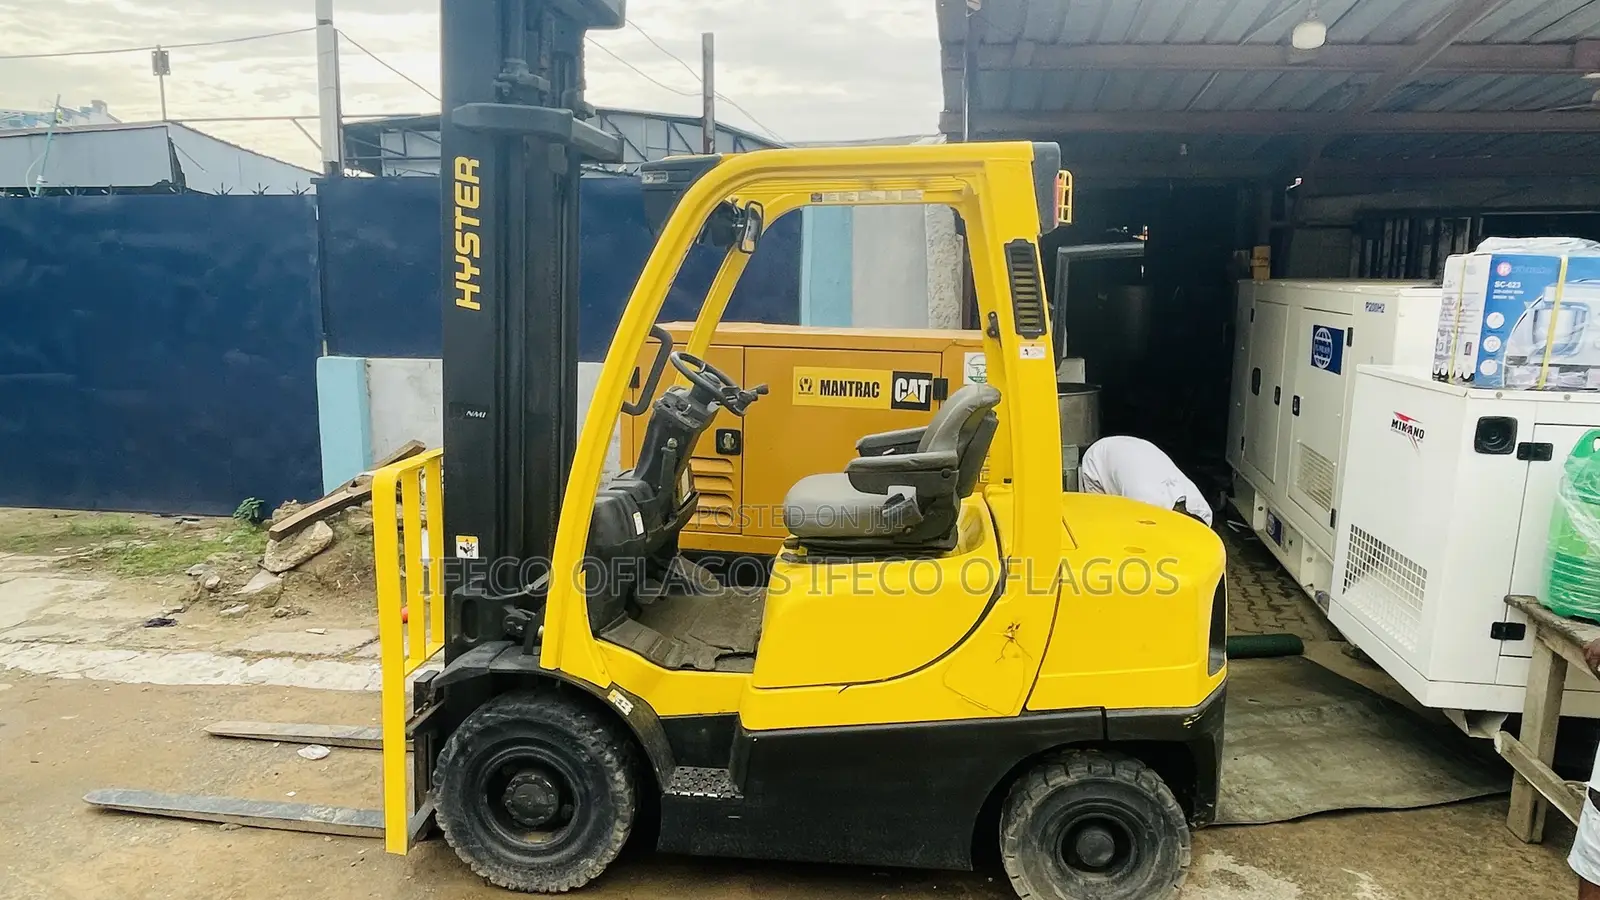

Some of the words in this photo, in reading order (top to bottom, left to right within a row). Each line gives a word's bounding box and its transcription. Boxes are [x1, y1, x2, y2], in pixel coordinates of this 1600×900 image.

[454, 156, 481, 311] HYSTER
[820, 379, 880, 399] MANTRAC
[894, 377, 931, 403] CAT
[1391, 418, 1425, 440] MIKANO
